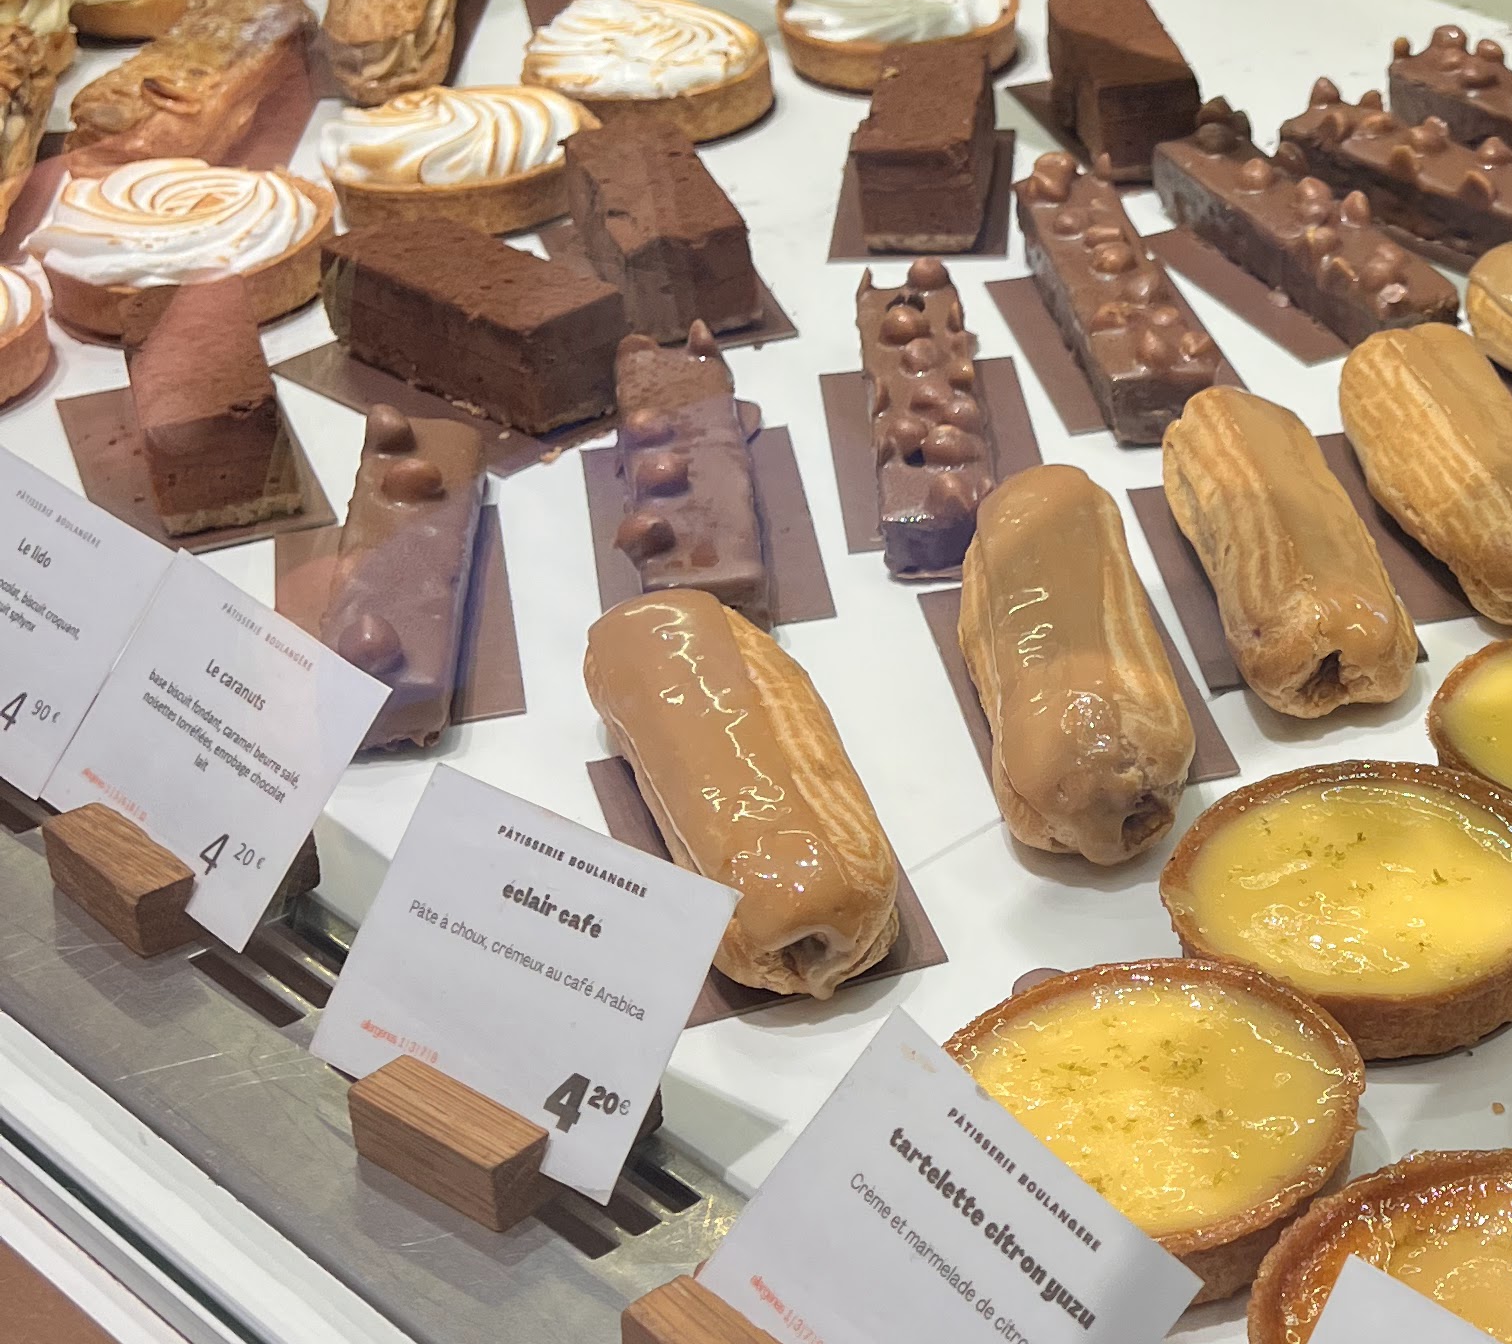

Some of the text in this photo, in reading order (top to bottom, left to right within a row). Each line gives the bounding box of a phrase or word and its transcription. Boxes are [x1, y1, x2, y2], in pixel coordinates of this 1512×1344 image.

[18, 538, 51, 568] Le lido
[206, 659, 265, 710] Le caranuts
[498, 825, 565, 861] PÂTISSERIE
[503, 880, 602, 938] éclair café
[409, 900, 645, 1021] Pâte à choux, crémeux au café Arabica
[948, 1108, 1016, 1174] PÂTISSERIE
[851, 1173, 891, 1219] Crème
[890, 1216, 907, 1234] et
[904, 1230, 975, 1302] marmelade
[976, 1299, 994, 1320] de
[890, 1128, 1096, 1330] tartelette citron yuzu
